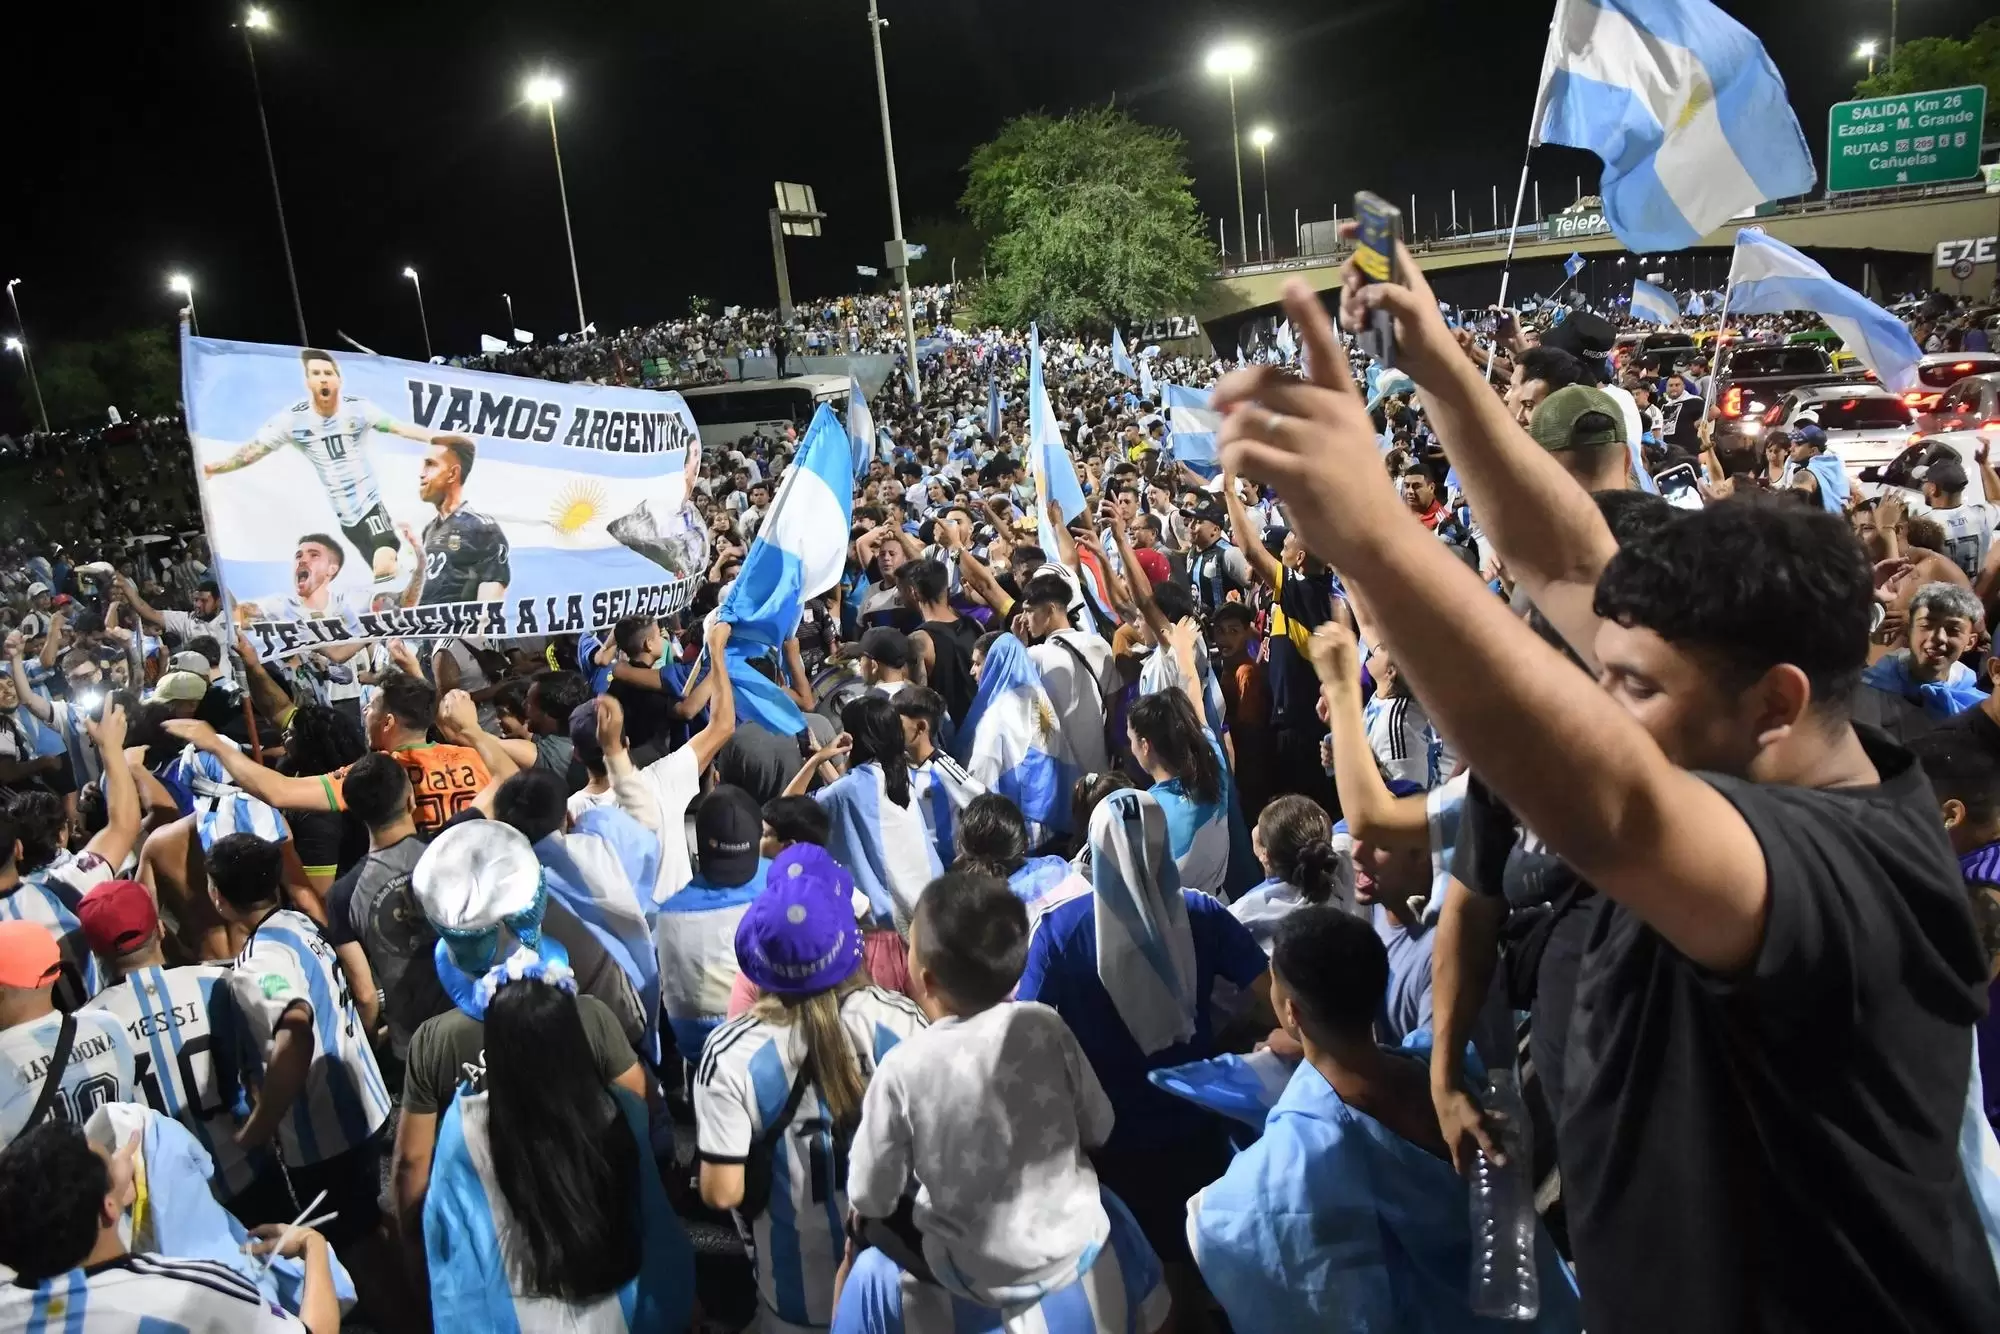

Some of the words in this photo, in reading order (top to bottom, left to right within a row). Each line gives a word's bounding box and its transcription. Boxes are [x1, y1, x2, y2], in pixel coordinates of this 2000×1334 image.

[1852, 102, 1909, 120] SALIDA
[1914, 99, 1939, 113] Km
[1943, 95, 1962, 109] 26
[1838, 122, 1885, 137] Ezeiza
[1896, 117, 1914, 130] M.
[1918, 110, 1974, 128] Grande
[1843, 141, 1889, 156] RUTAS
[1869, 153, 1937, 170] Cañuelas
[1937, 236, 1997, 266] EZE
[408, 380, 562, 443] VAMOS
[564, 407, 689, 453] ARGENTINA
[321, 434, 347, 461] 10
[365, 515, 385, 537] 10
[516, 599, 539, 634] A
[547, 594, 585, 633] LA
